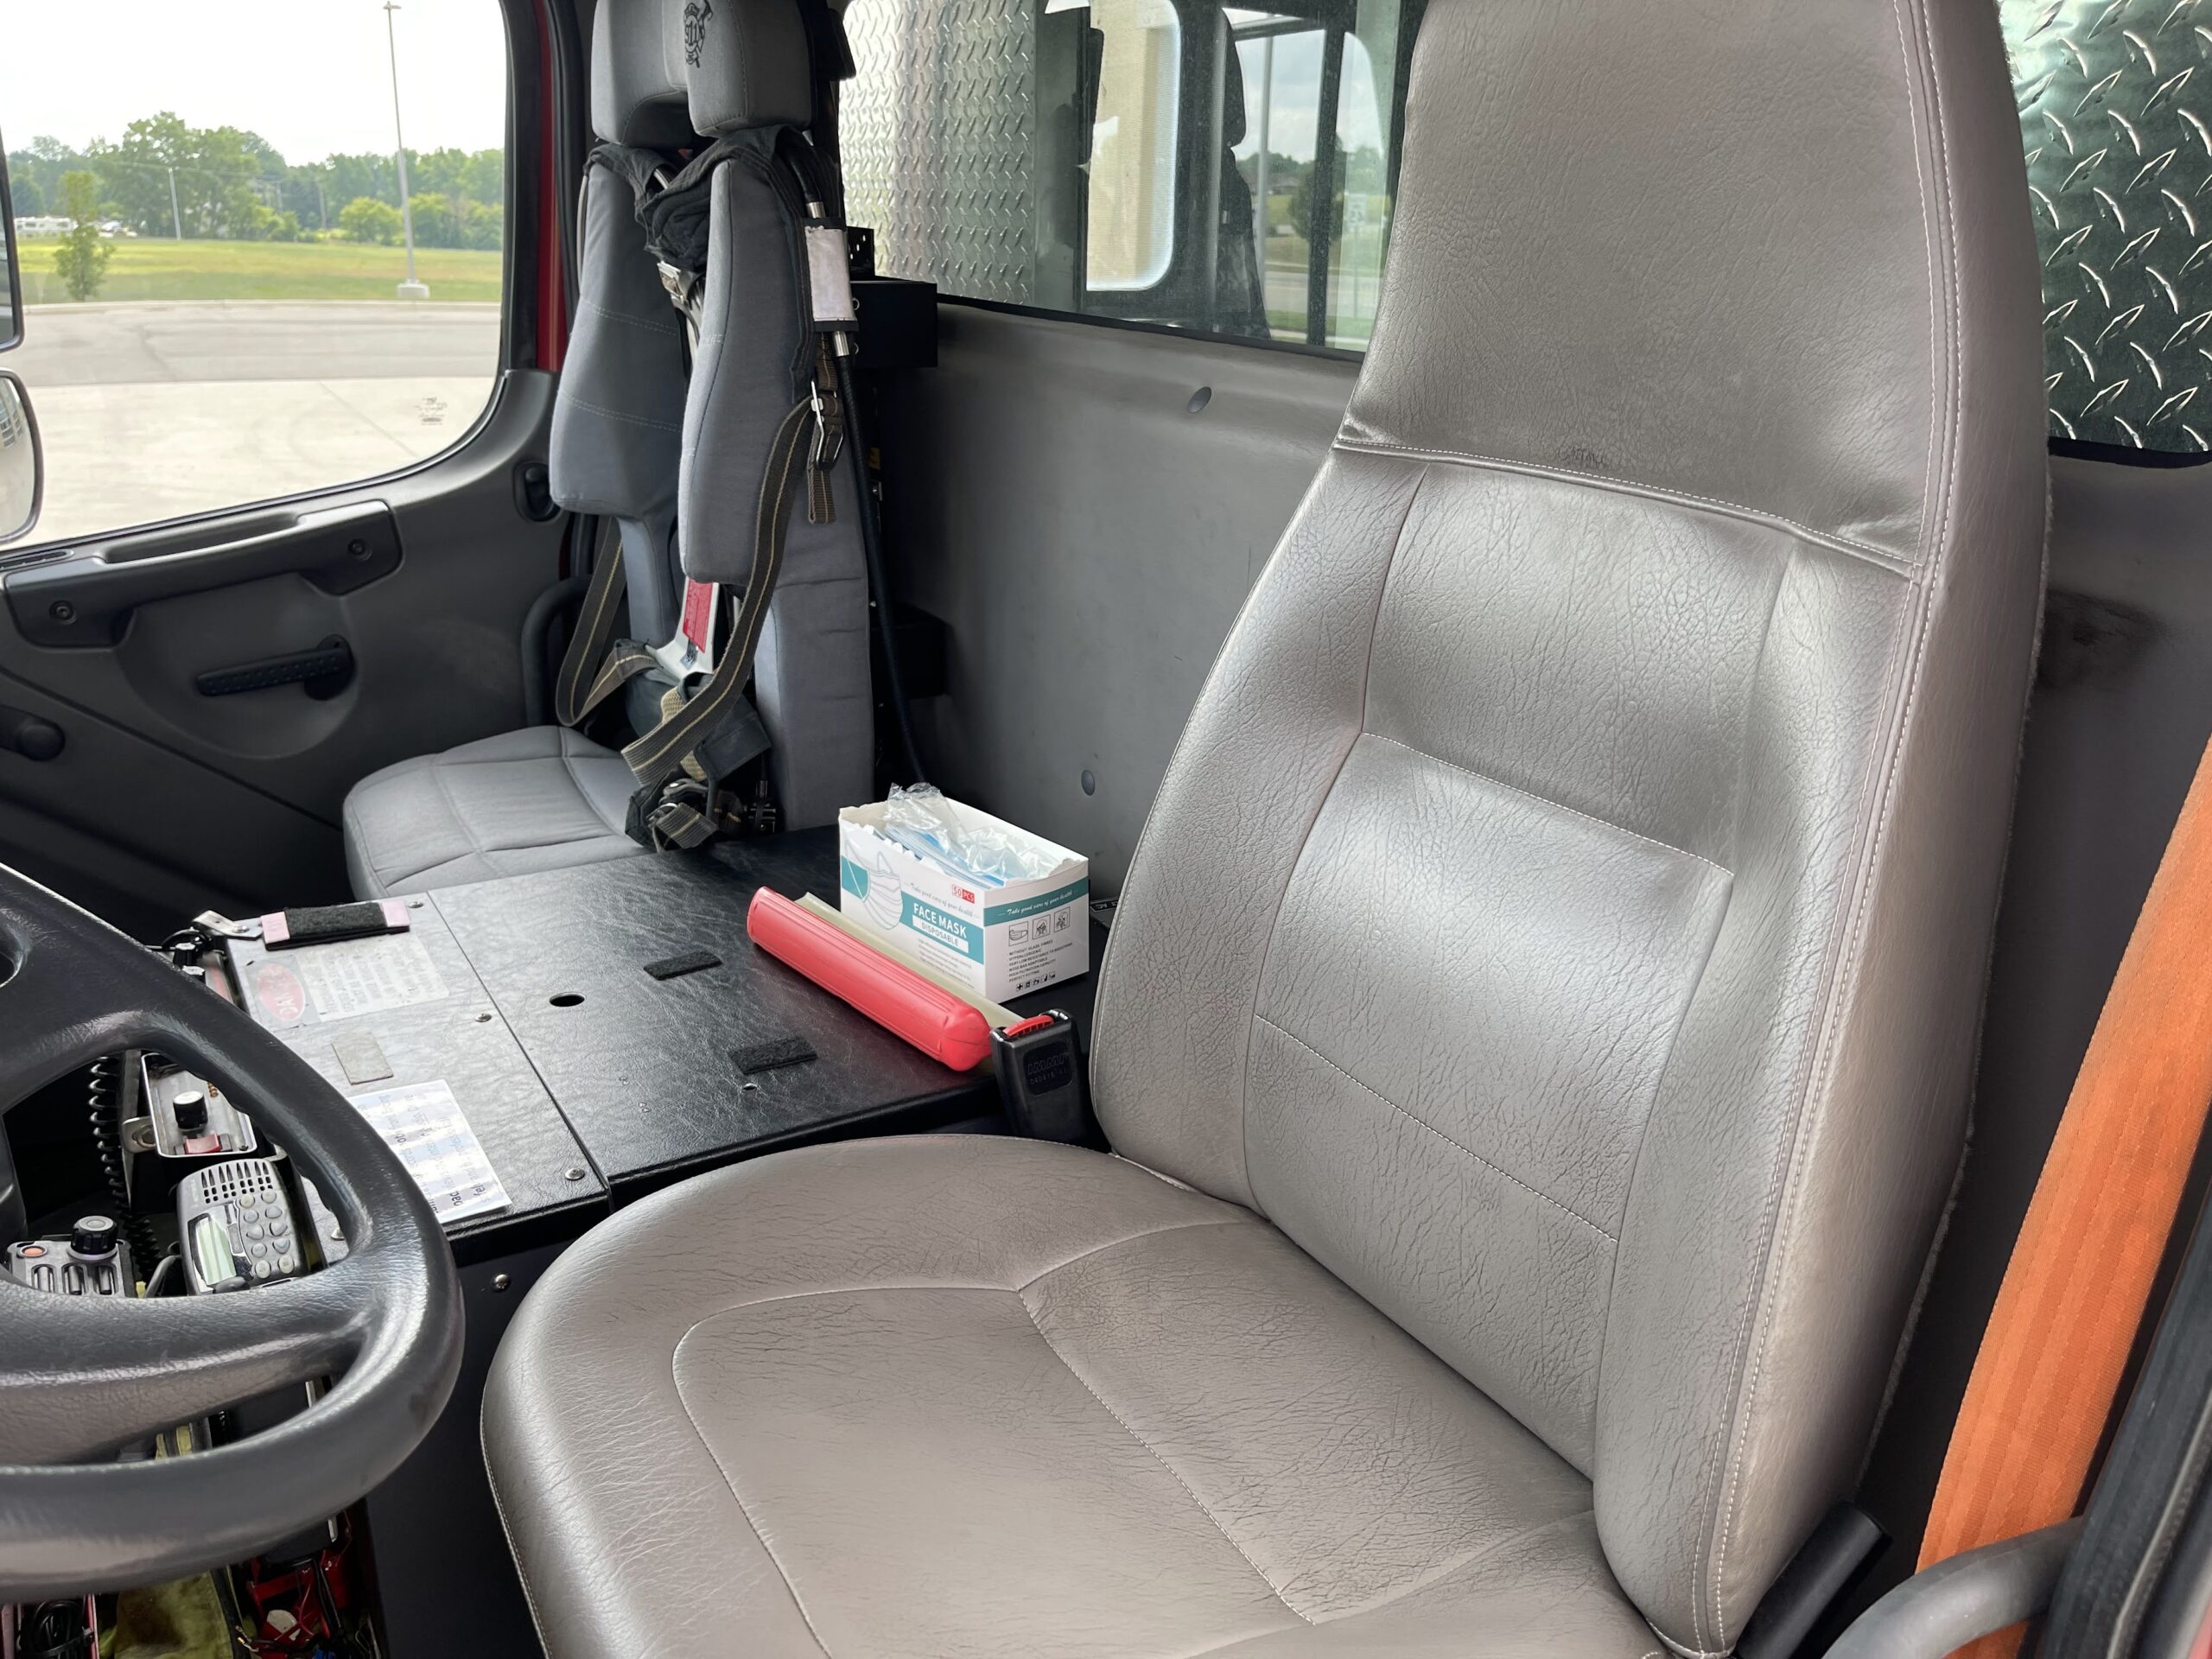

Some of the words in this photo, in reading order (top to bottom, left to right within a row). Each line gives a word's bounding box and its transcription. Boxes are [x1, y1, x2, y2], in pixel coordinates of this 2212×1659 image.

[953, 887, 961, 897] 50
[963, 890, 976, 903] PCS
[1007, 907, 1020, 916] Take
[1020, 904, 1033, 913] good
[1049, 896, 1059, 905] your
[1059, 891, 1072, 899] health
[913, 902, 937, 925] FACE
[938, 914, 967, 938] MASK
[921, 922, 959, 946] DISPOSABLE
[1009, 947, 1027, 957] WITHOUT
[1009, 950, 1042, 961] HYPOALLERGENIC
[1009, 974, 1025, 983] PERFECT
